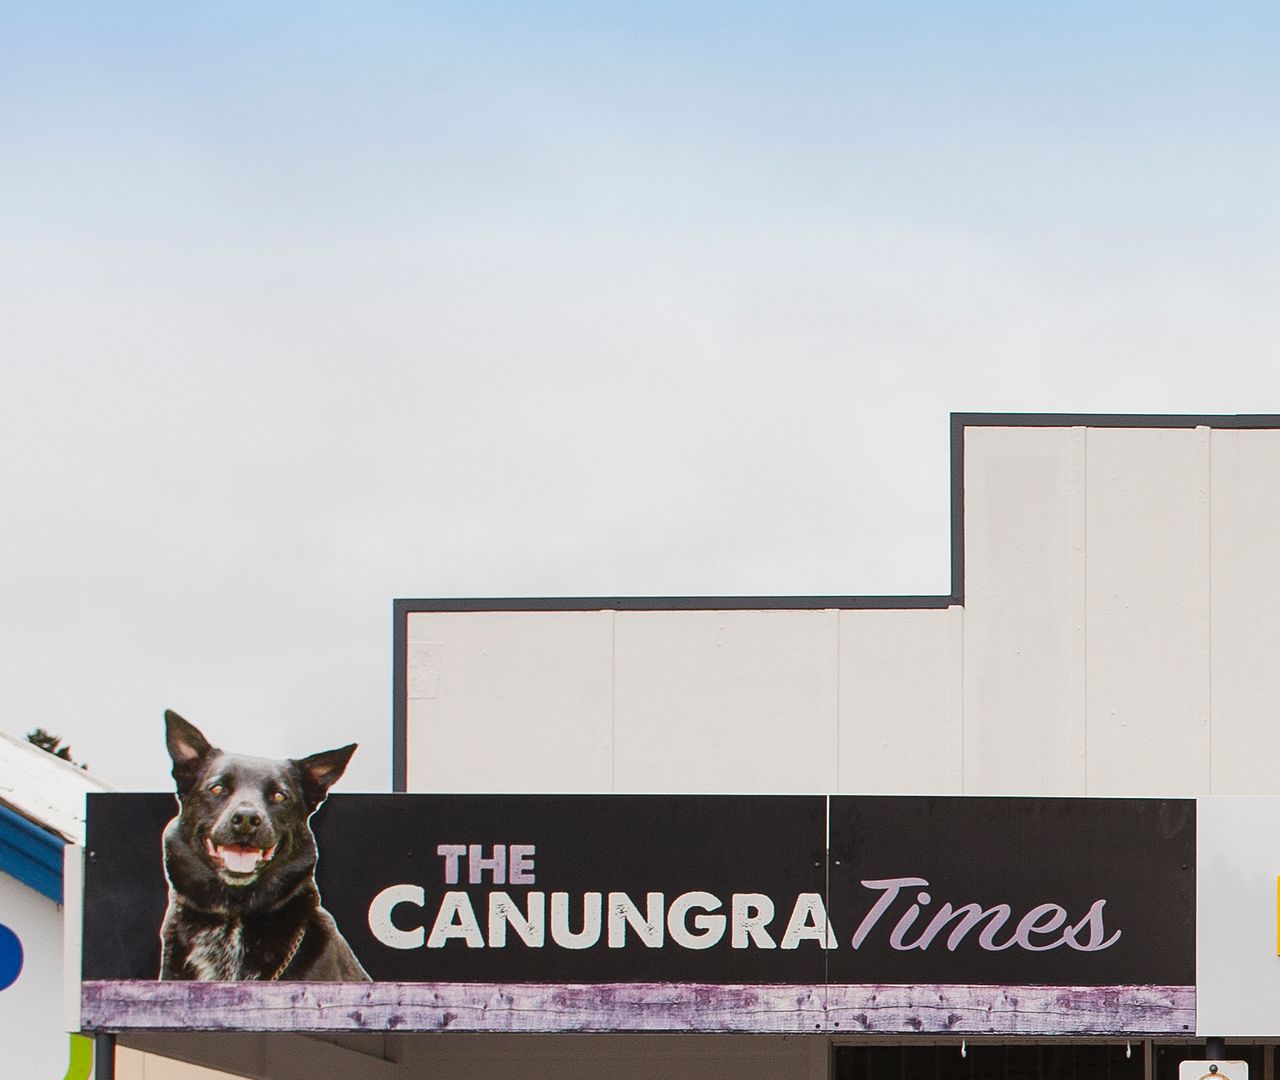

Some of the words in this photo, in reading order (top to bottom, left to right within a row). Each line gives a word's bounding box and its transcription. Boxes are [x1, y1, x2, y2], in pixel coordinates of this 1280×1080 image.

[437, 844, 536, 885] THE
[368, 884, 838, 950] CANUNGRA
[851, 877, 1122, 952] Times
